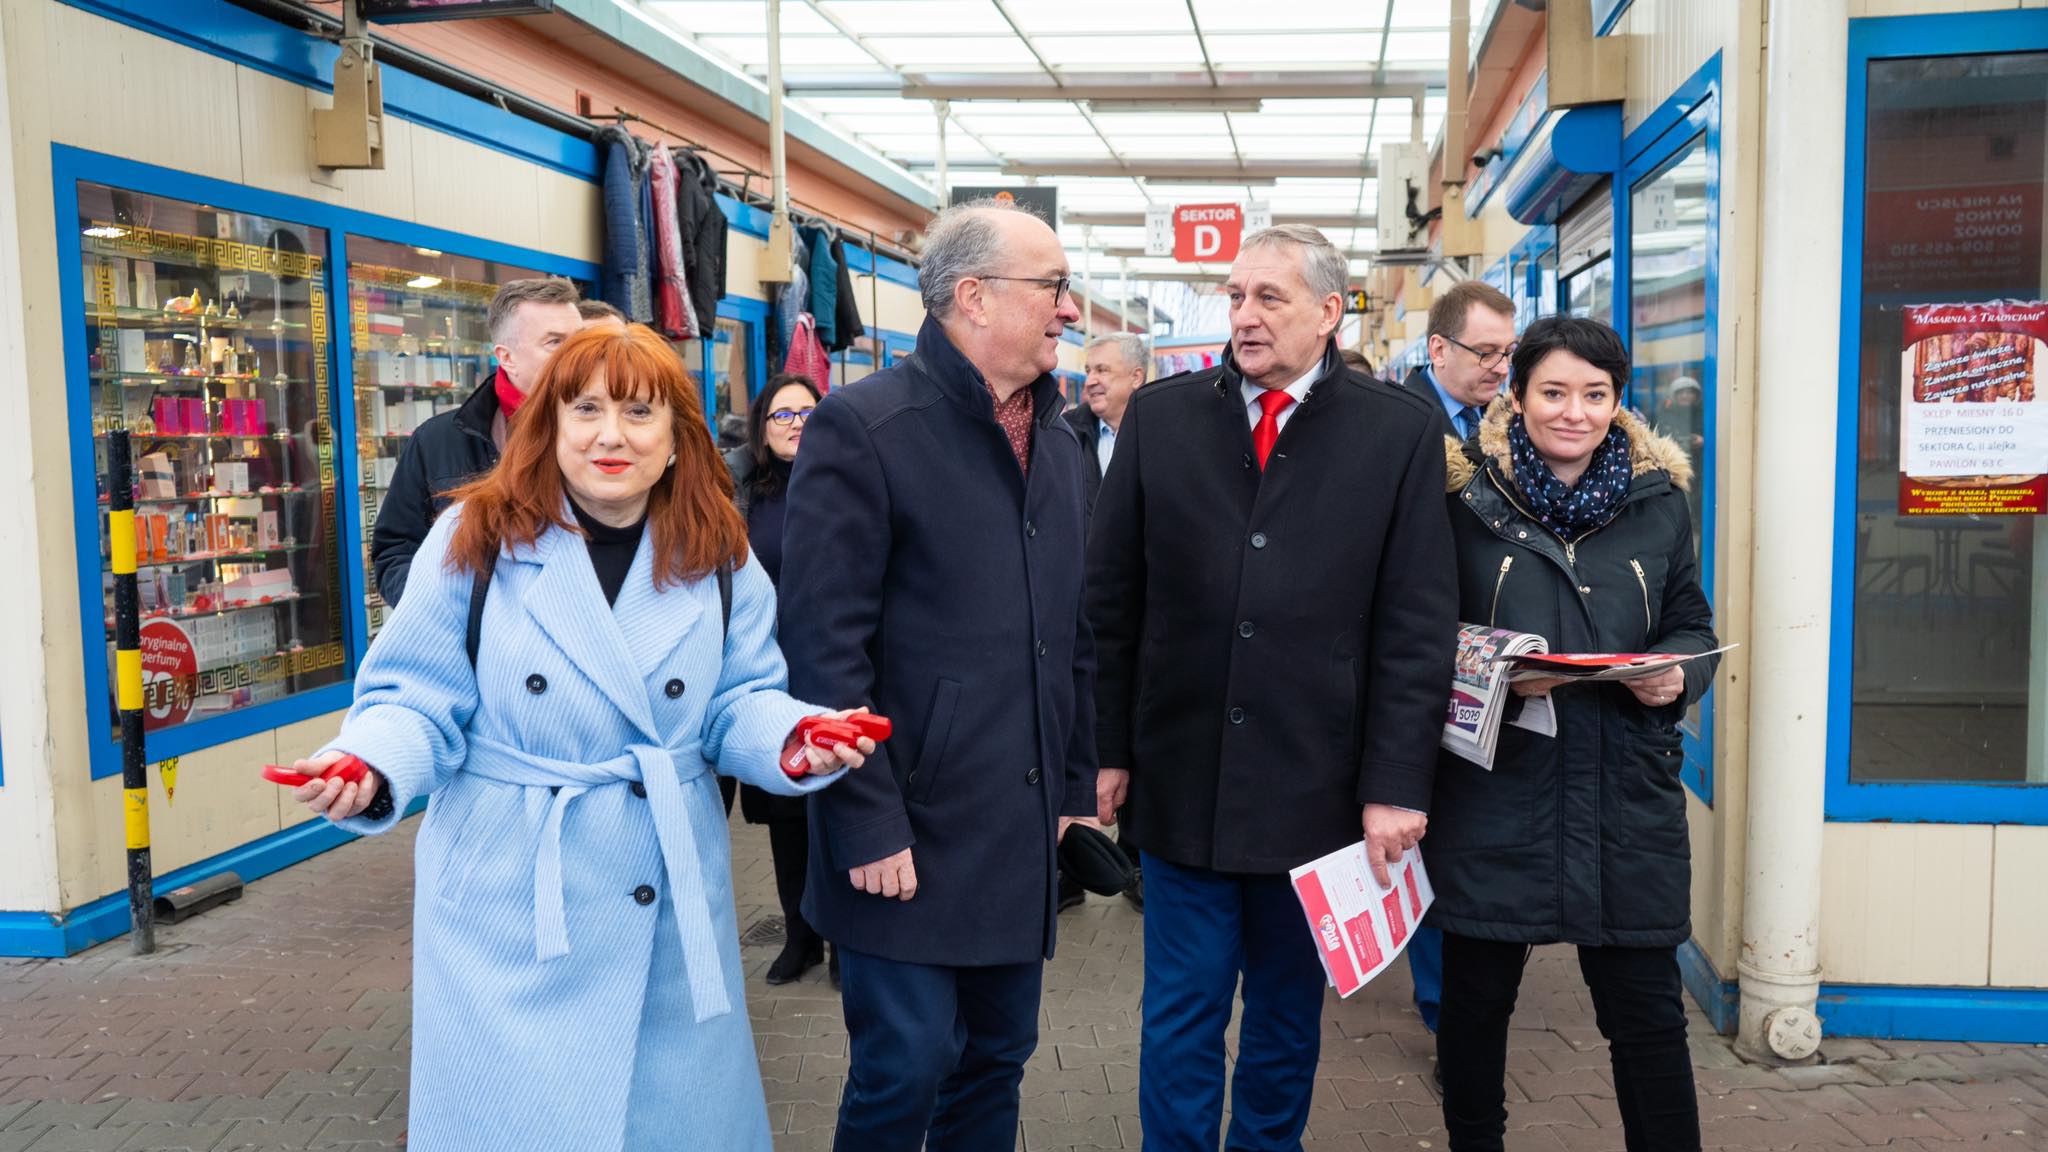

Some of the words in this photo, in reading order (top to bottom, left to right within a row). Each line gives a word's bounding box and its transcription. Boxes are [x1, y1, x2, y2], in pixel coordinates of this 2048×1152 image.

[1180, 208, 1236, 222] SEKTOR
[1194, 224, 1222, 257] D
[1924, 355, 1970, 372] Zawsze
[1924, 370, 1970, 386] Zawsze
[1923, 385, 1970, 401] Zawsze
[1922, 408, 1951, 418] SKLEP
[1925, 426, 1995, 435] PRZENIESIONY
[1998, 425, 2015, 434] DO
[1920, 442, 1964, 451] SEKTORA
[1987, 440, 2017, 452] alejka
[1930, 459, 1977, 468] PAWILON
[138, 635, 188, 653] oryginalne
[142, 650, 181, 670] perfumy
